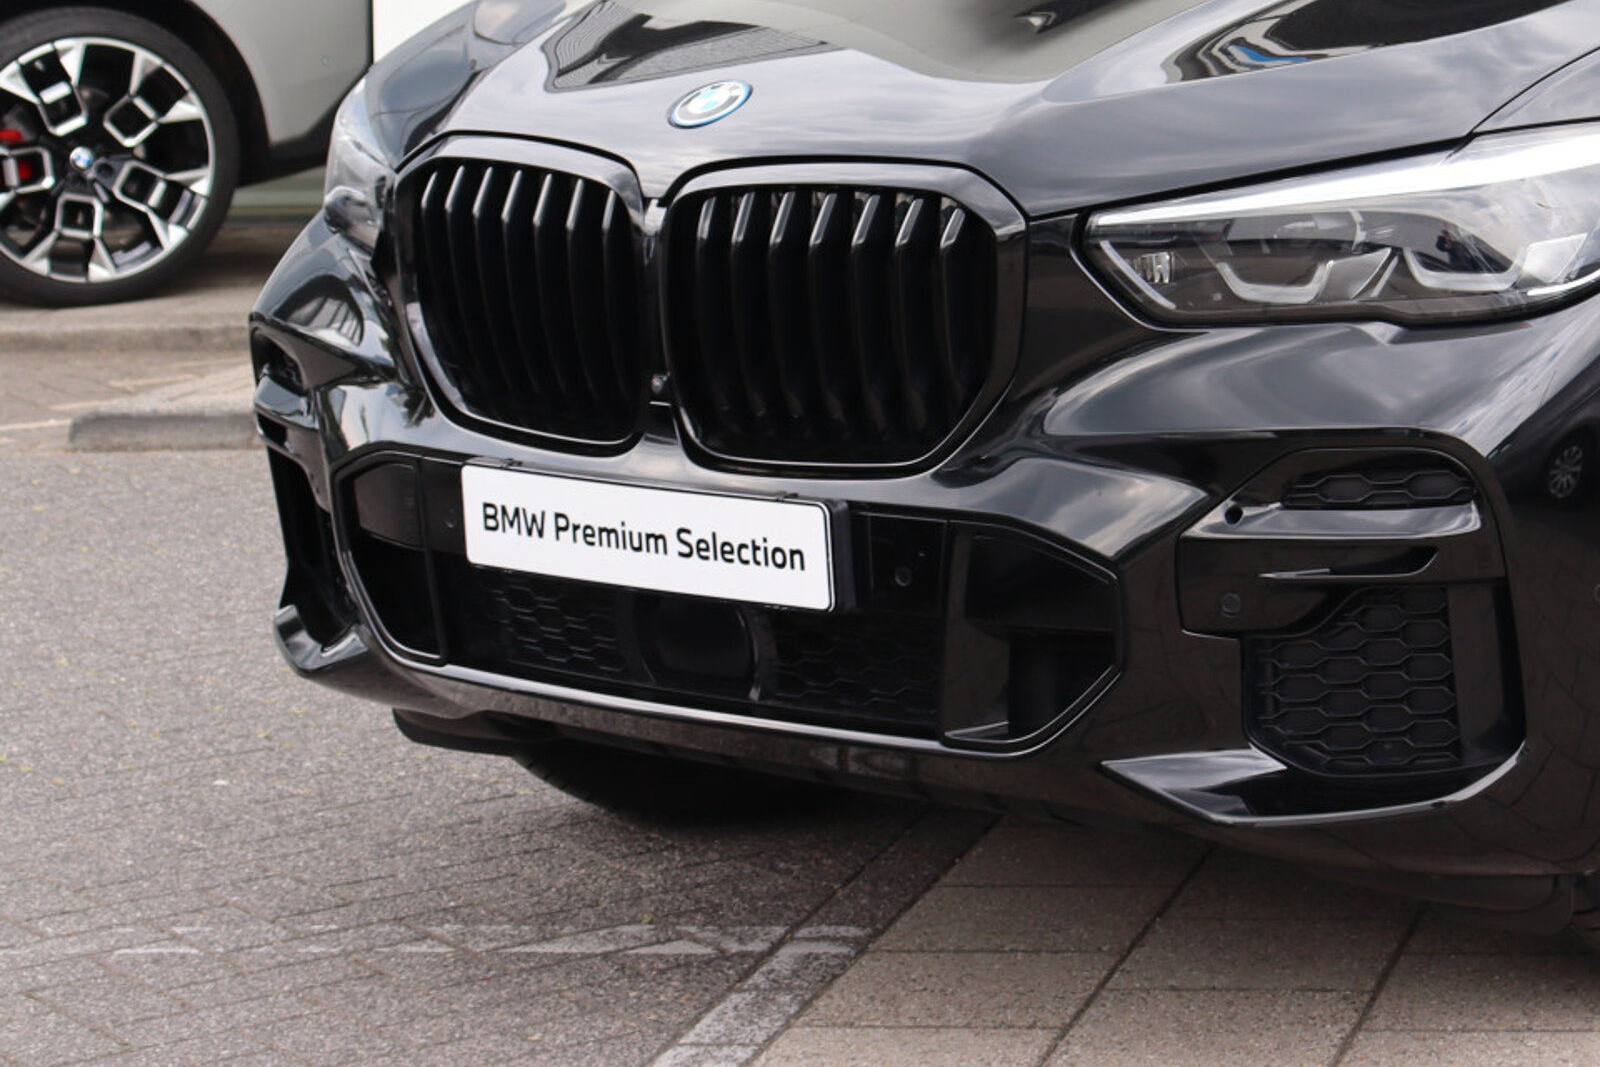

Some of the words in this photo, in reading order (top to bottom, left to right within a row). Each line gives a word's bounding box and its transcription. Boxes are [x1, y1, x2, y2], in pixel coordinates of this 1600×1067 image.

[483, 502, 545, 541] BMW
[555, 513, 668, 556] Premium
[677, 527, 805, 571] Selection
